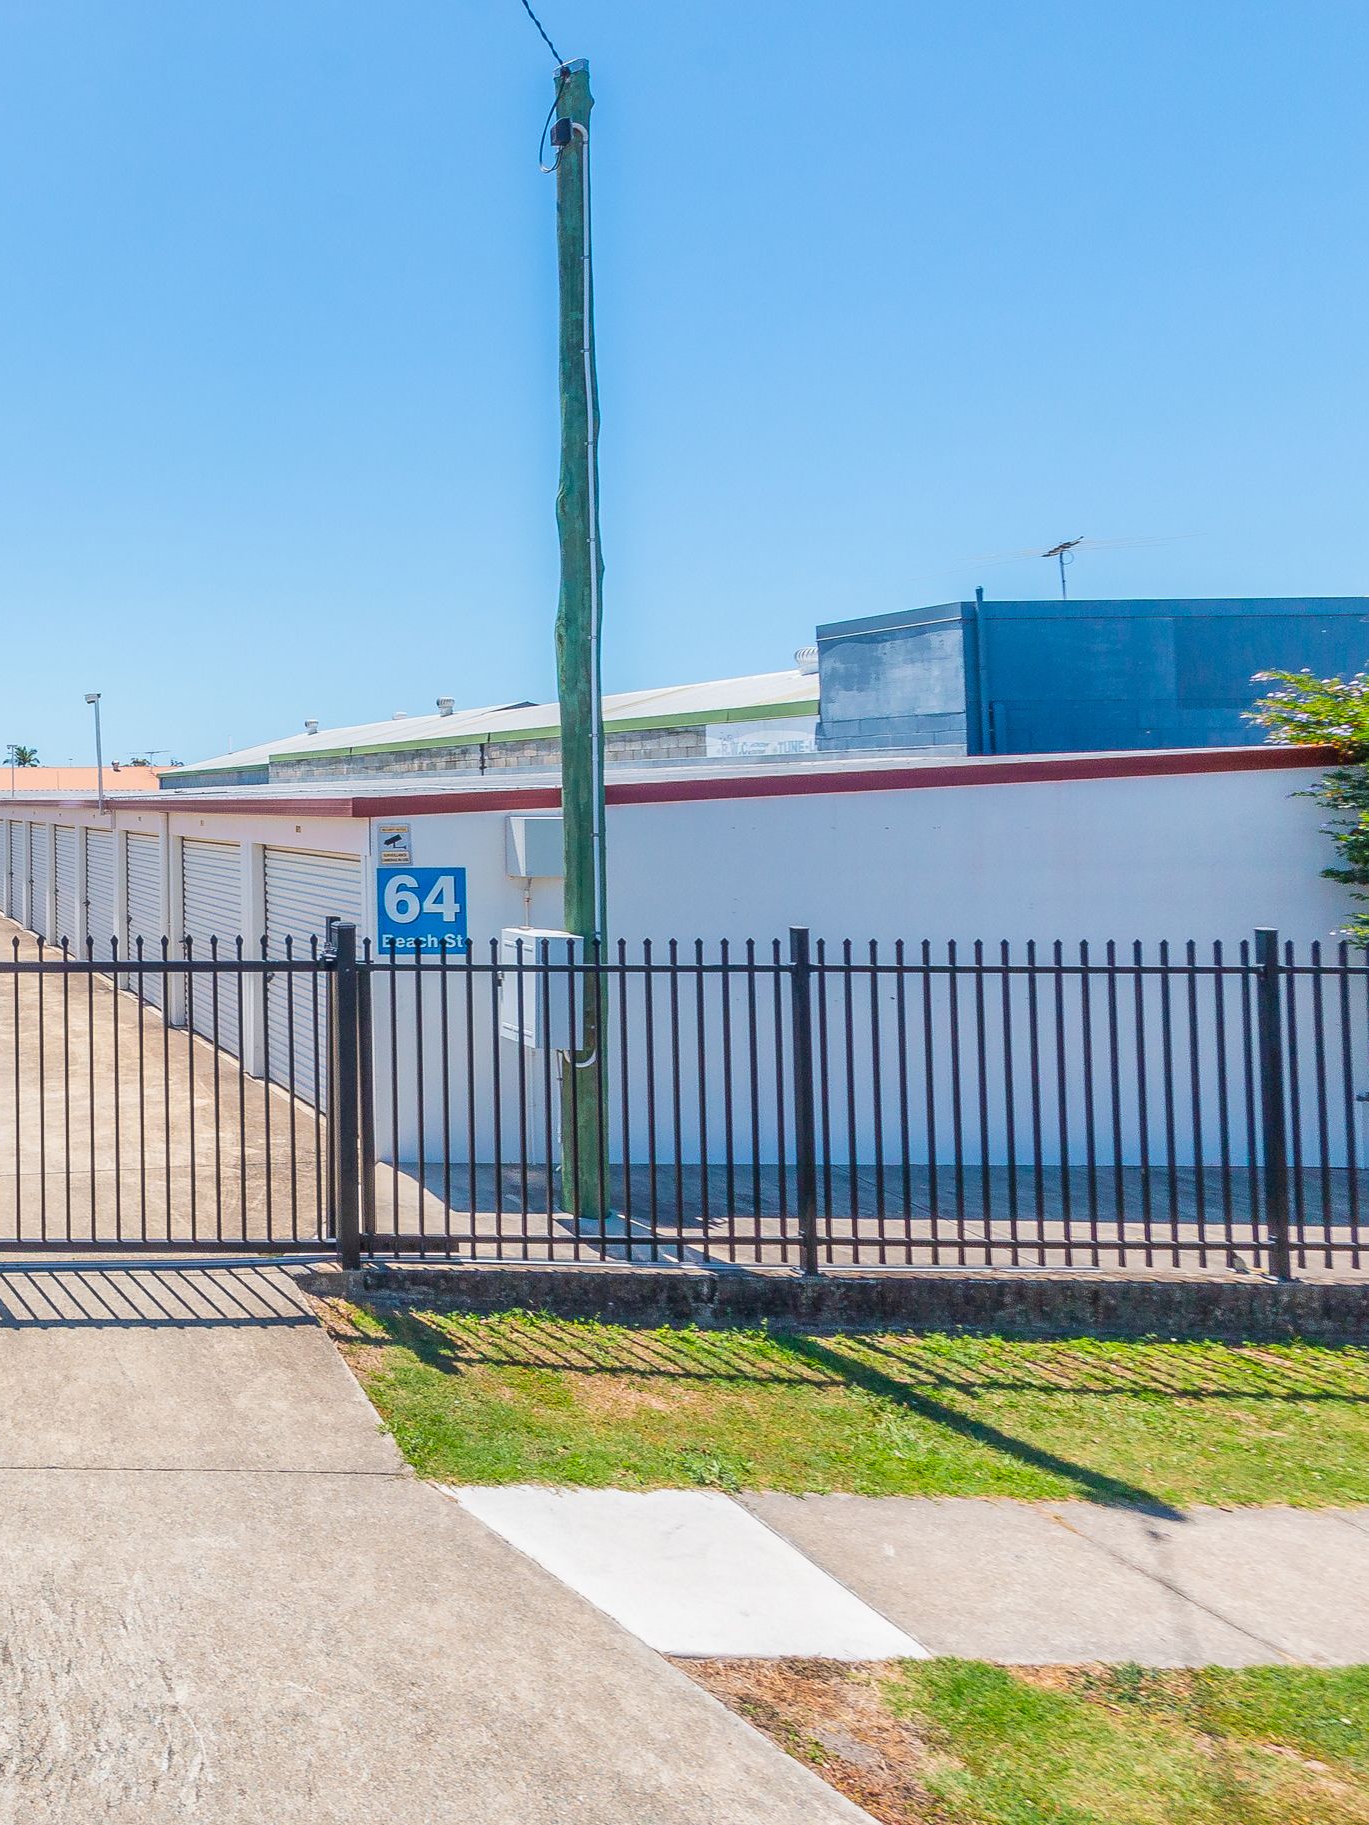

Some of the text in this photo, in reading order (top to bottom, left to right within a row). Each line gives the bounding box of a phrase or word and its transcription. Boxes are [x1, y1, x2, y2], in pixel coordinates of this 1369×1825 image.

[384, 874, 461, 924] 64
[382, 933, 464, 948] Beach St
